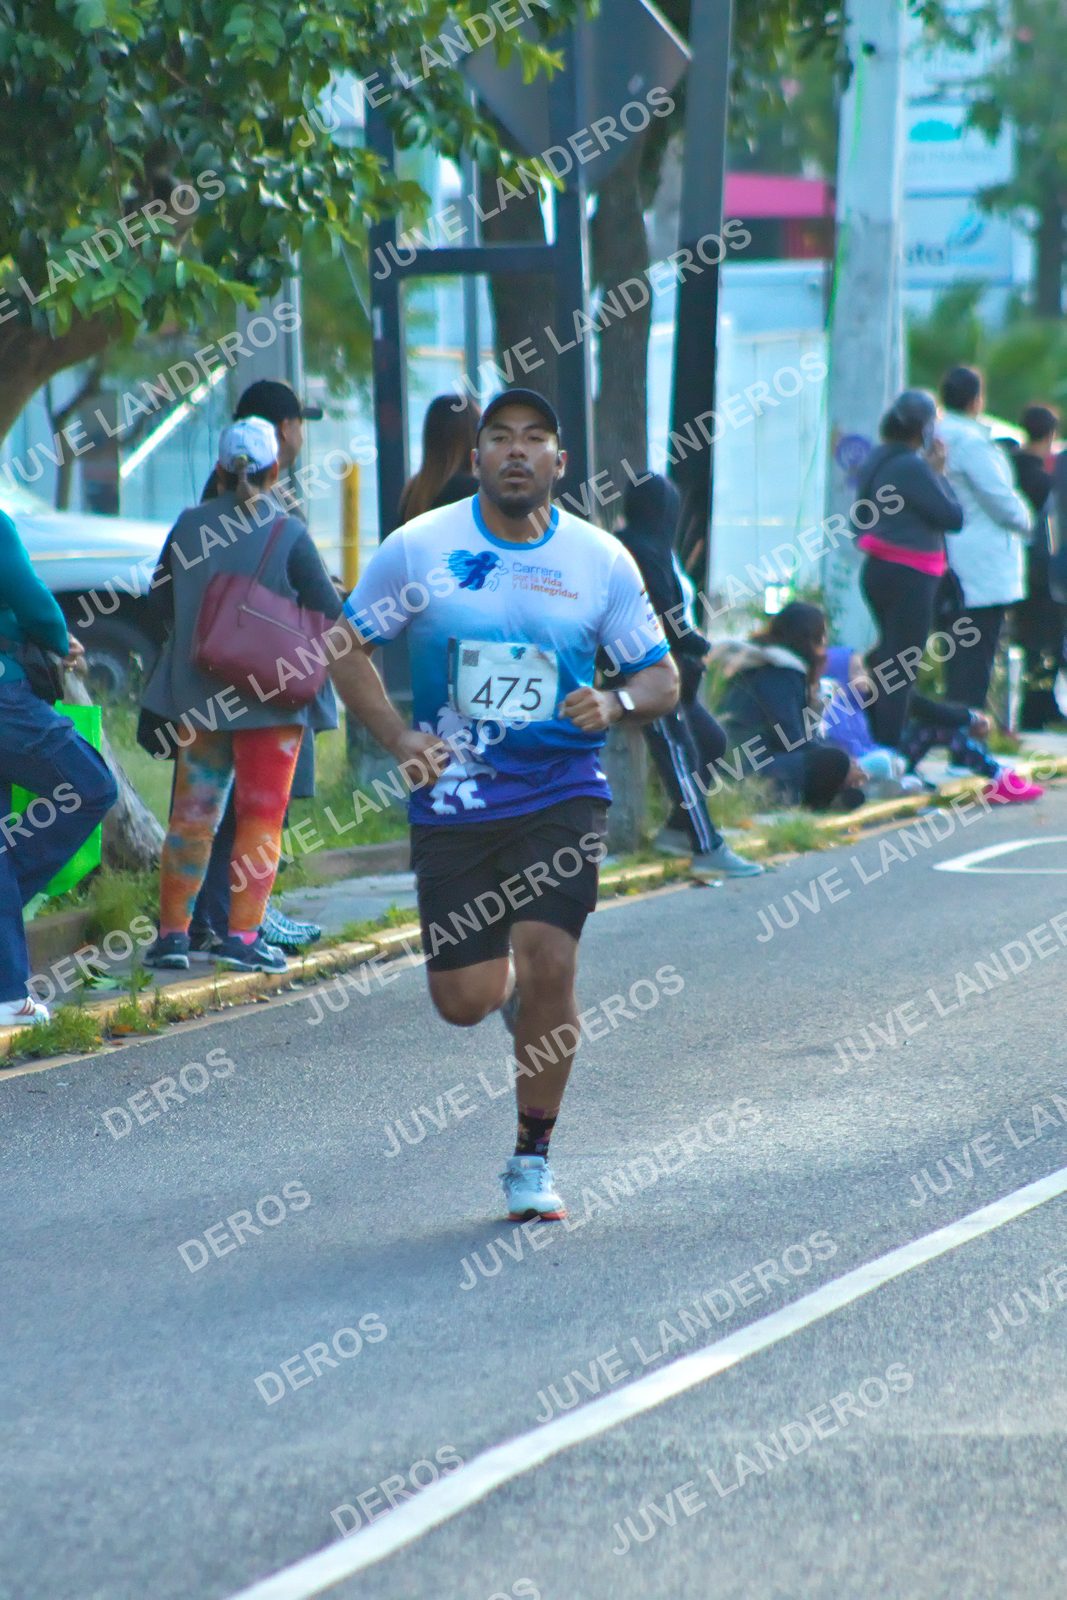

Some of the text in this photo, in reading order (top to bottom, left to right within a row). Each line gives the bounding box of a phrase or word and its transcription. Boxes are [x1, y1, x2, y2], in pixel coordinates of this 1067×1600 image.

[512, 562, 561, 579] Carrera
[541, 576, 562, 587] Vida
[530, 583, 578, 600] Integridad
[470, 676, 542, 711] 475
